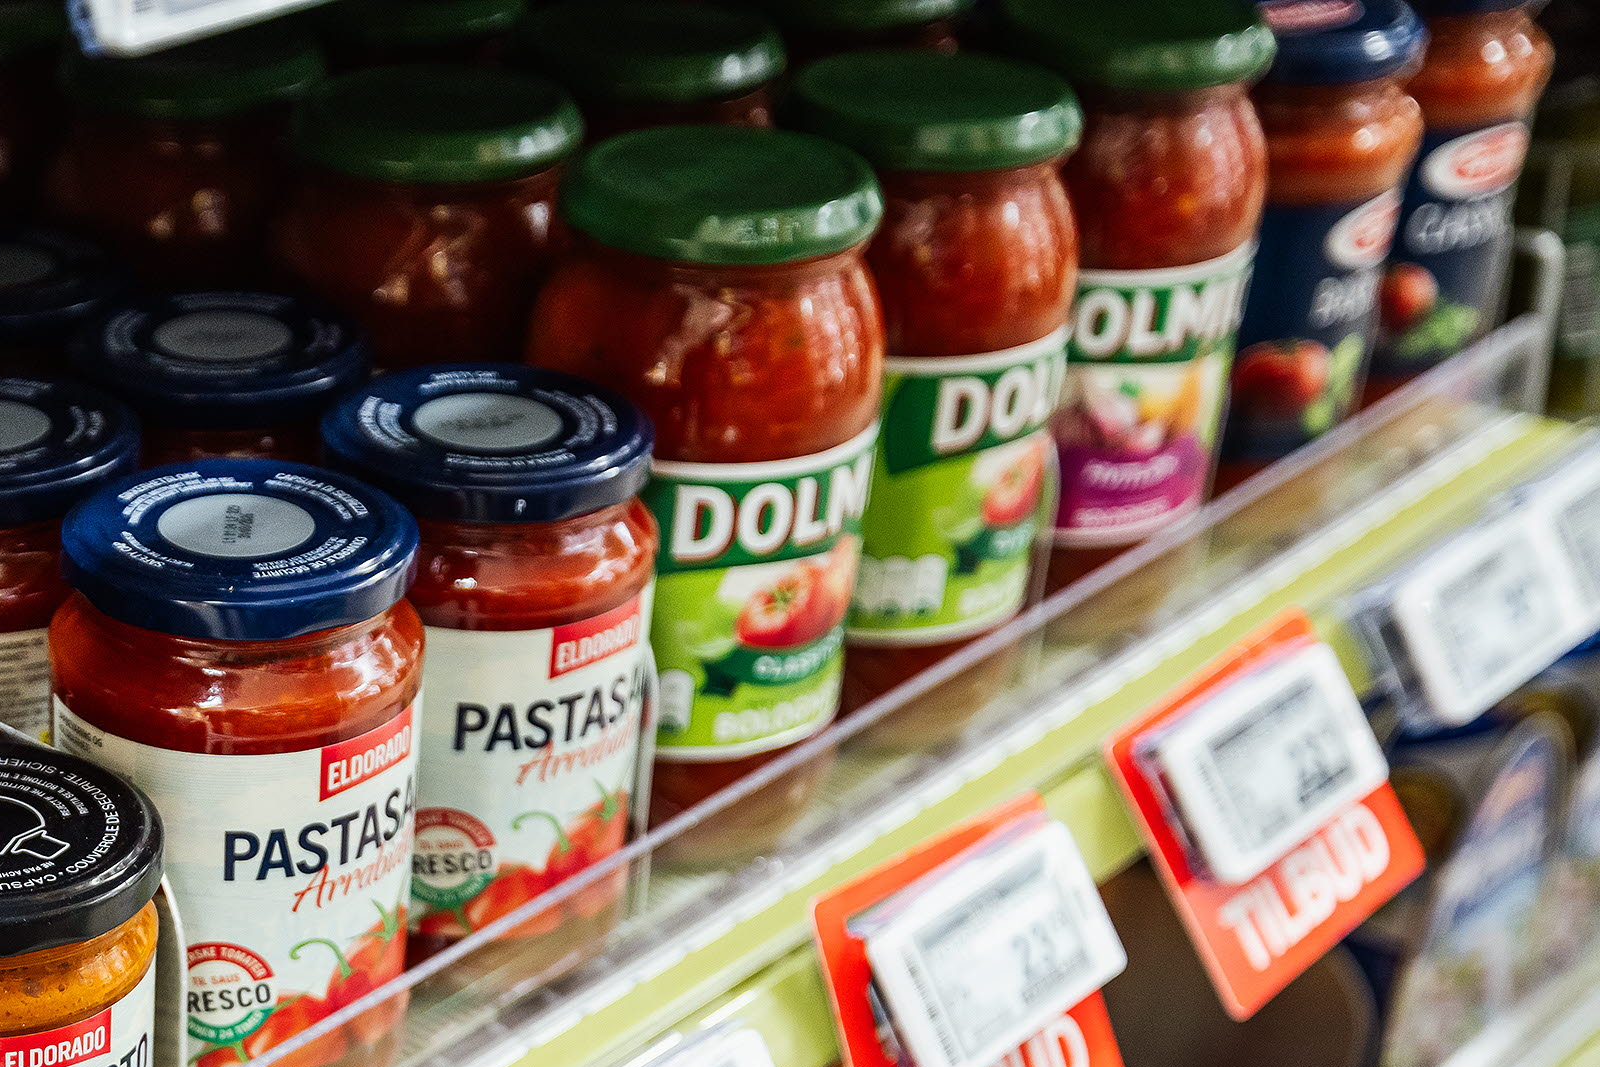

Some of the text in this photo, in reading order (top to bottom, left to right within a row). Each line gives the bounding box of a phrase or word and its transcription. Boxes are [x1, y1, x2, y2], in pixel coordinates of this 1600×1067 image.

[1076, 281, 1248, 355] OLM
[671, 450, 875, 560] DOLM
[65, 811, 121, 874] COUVERCLE DE
[223, 774, 415, 882] PASTASA
[411, 849, 493, 875] RESCO
[1217, 801, 1391, 973] TILBUD
[187, 983, 271, 1013] RESCO
